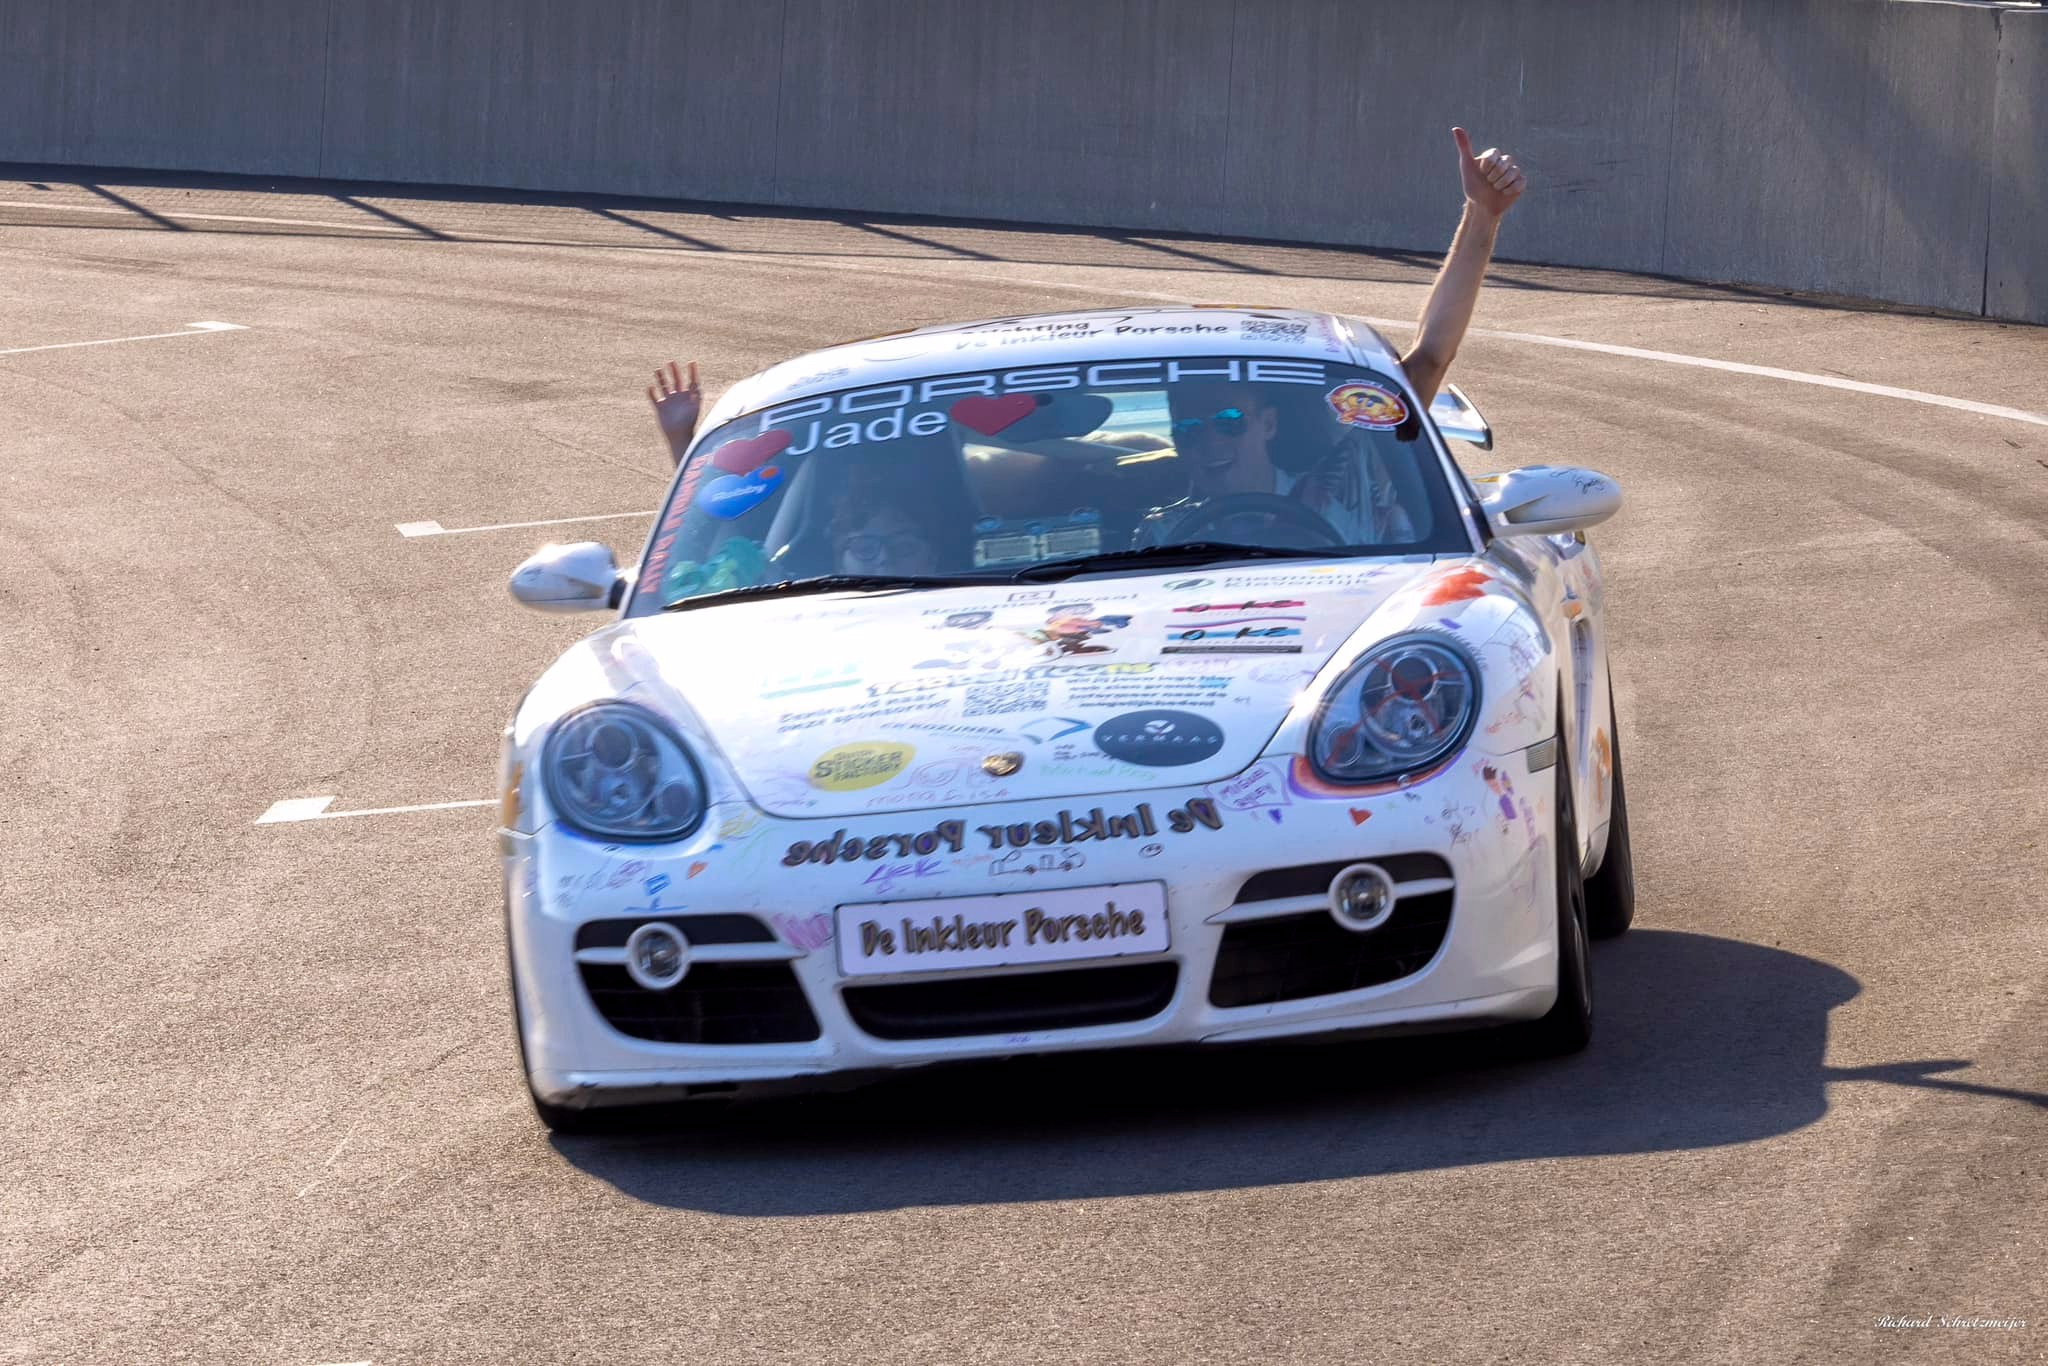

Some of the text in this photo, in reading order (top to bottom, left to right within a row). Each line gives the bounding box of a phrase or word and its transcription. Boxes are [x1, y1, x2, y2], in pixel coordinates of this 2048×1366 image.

[1114, 323, 1229, 336] Porsche
[757, 359, 1326, 437] PORSCHE
[786, 406, 948, 457] Jade
[1101, 734, 1218, 744] VERMAAS
[861, 901, 1147, 957] De Inkleur Porsche
